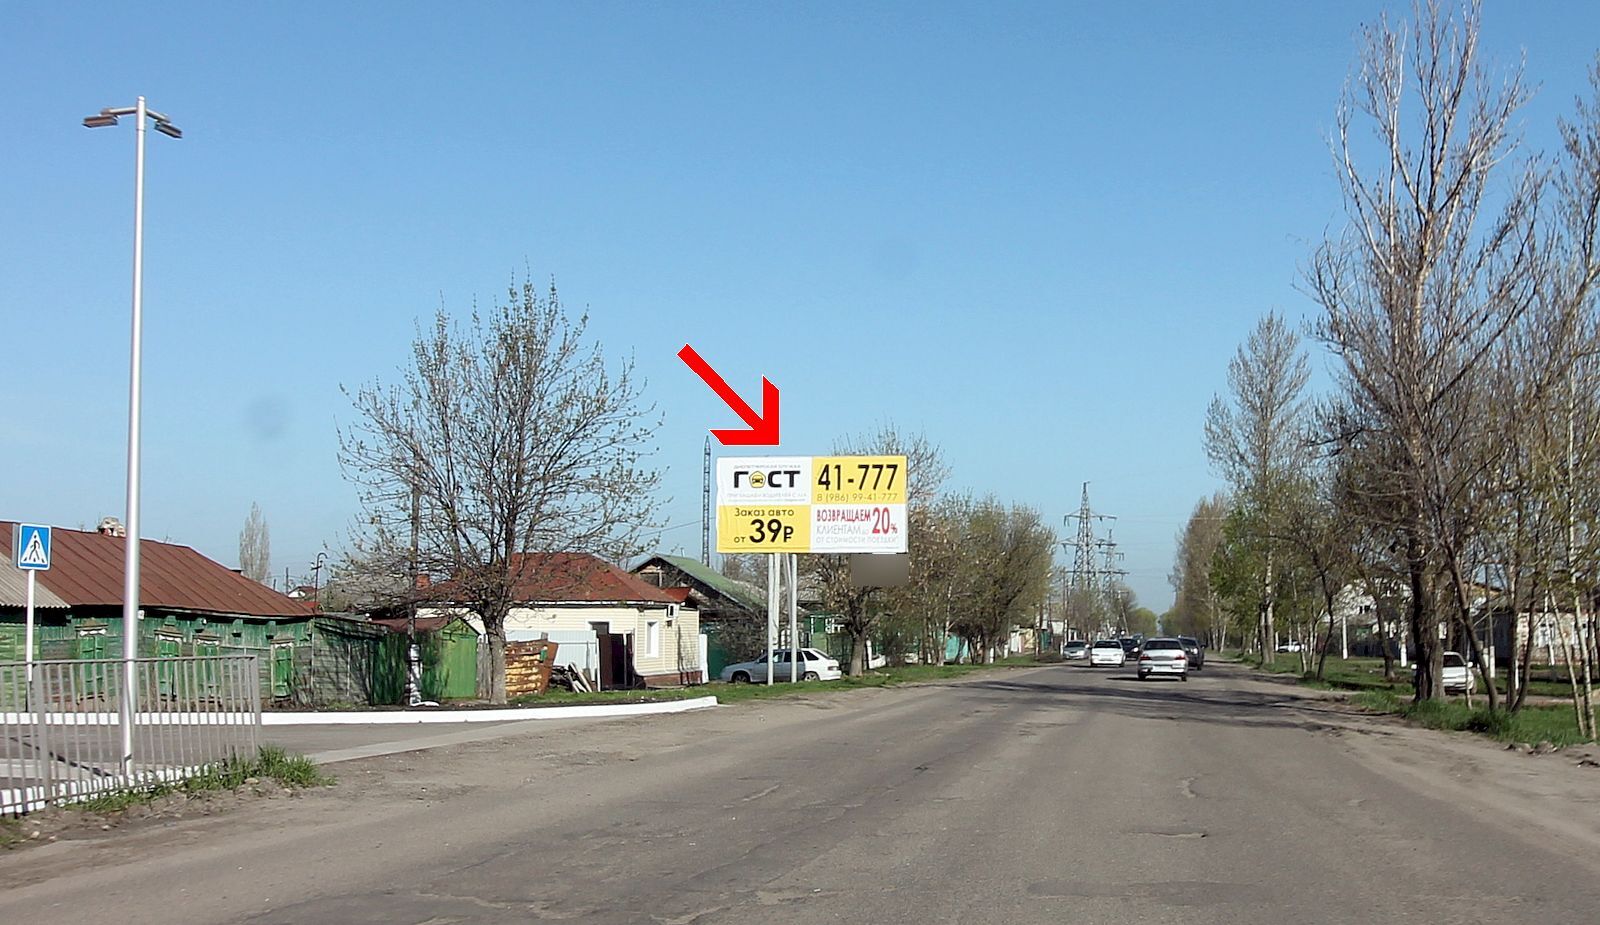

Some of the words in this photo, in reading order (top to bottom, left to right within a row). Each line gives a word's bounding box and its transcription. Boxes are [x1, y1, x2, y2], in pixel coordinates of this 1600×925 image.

[818, 464, 898, 490] 41-777
[816, 493, 823, 501] 8
[826, 493, 849, 502] (986)
[852, 493, 898, 501] 99-41-777
[734, 507, 766, 517] Заказ
[768, 509, 795, 517] авто
[816, 509, 872, 522] ВОЗВРАЩАЕМ
[872, 507, 898, 534] 20%
[816, 525, 861, 535] КЛИЕНТАМ
